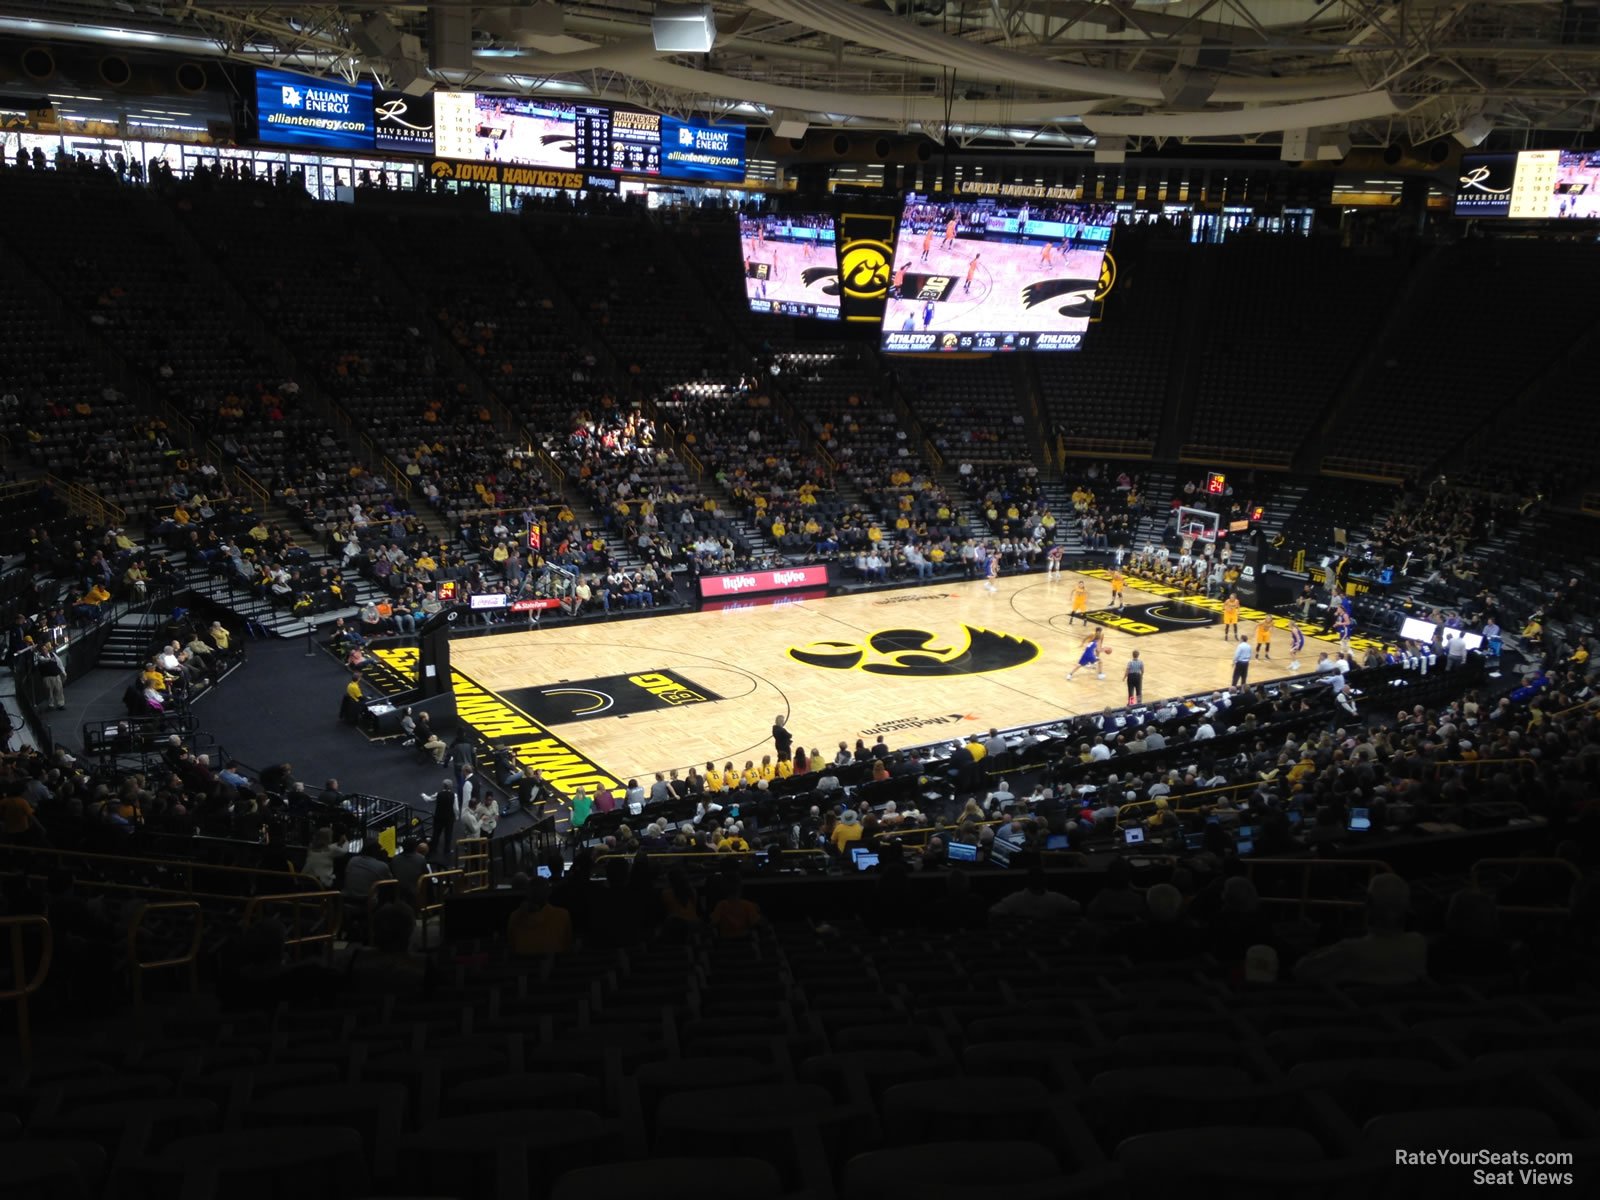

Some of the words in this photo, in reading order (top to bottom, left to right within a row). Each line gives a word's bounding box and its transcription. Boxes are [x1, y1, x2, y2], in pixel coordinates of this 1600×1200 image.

[306, 88, 350, 104] ALLIANT
[306, 98, 350, 114] ENERGY
[268, 113, 366, 132] alliantenergy.com
[614, 112, 660, 125] HAWKEYES
[376, 127, 434, 138] RIVERSIDE
[696, 131, 728, 142] ALLIANT
[696, 140, 728, 150] ENERGY
[614, 152, 625, 160] 55
[648, 155, 658, 164] 61
[668, 152, 739, 166] alliantenergy.com
[455, 163, 498, 182] IOWA
[502, 168, 584, 189] HAWKEYES
[962, 182, 1046, 198] CARVER-HAWKEYE
[1048, 188, 1077, 199] ARENA
[886, 333, 936, 345] ATHLETICO
[961, 337, 972, 346] 55
[978, 337, 995, 347] 1:58
[1020, 337, 1030, 346] 61
[1037, 333, 1081, 344] ATHLETICO
[1210, 480, 1222, 492] 24
[440, 590, 452, 598] 24
